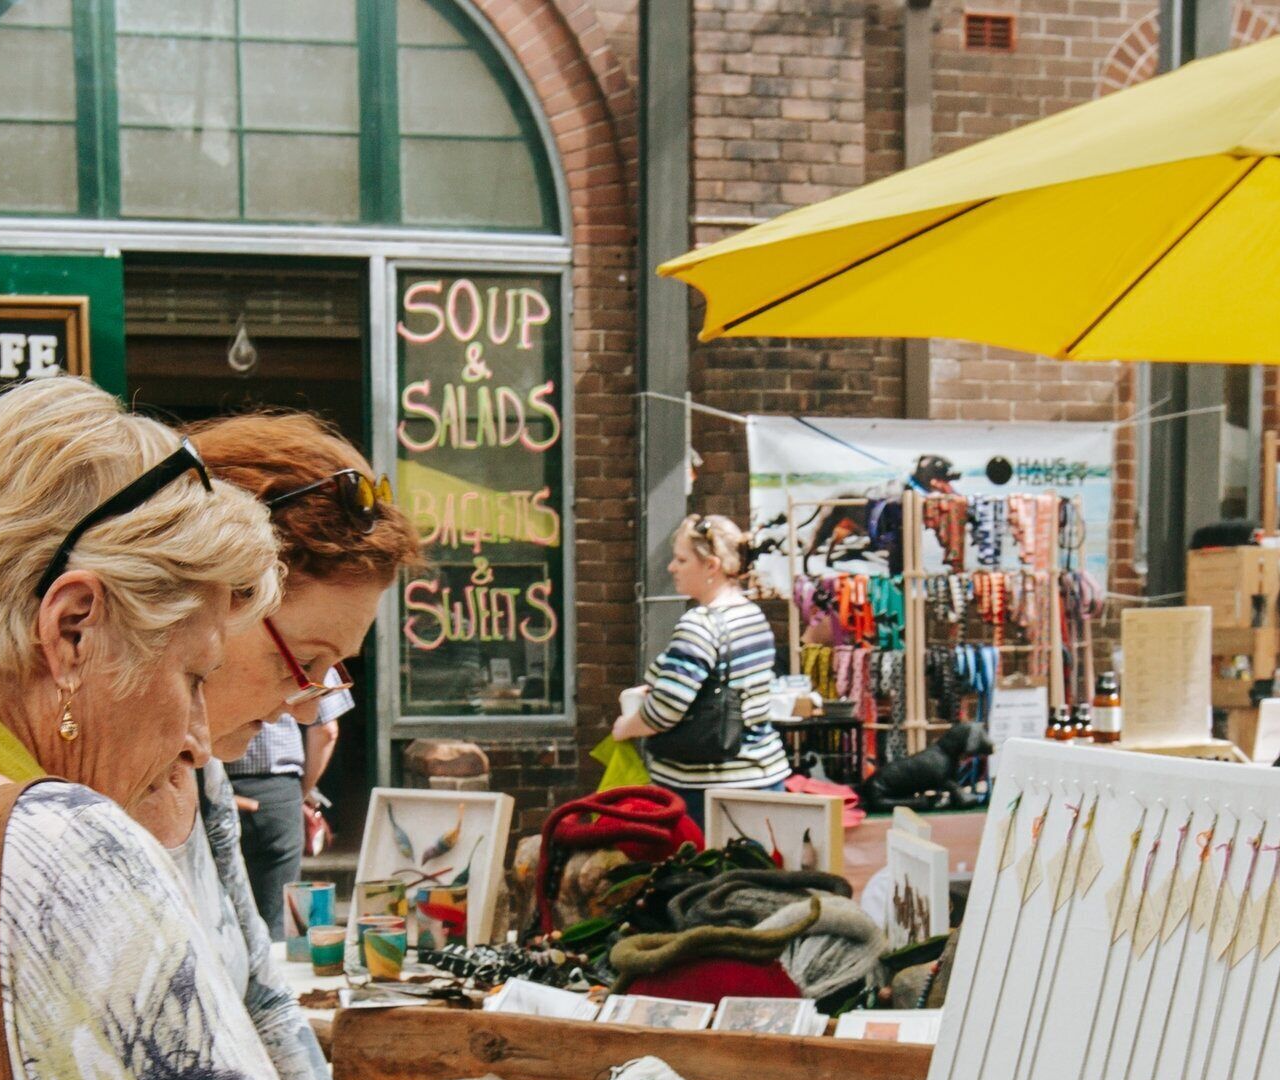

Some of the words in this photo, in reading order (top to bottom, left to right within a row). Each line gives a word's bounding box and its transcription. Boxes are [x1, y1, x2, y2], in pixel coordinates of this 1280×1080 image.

[397, 278, 551, 350] SOUP
[462, 341, 493, 383] &
[397, 379, 561, 455] SALADS
[471, 556, 494, 585] &
[403, 578, 558, 651] SWEETS
